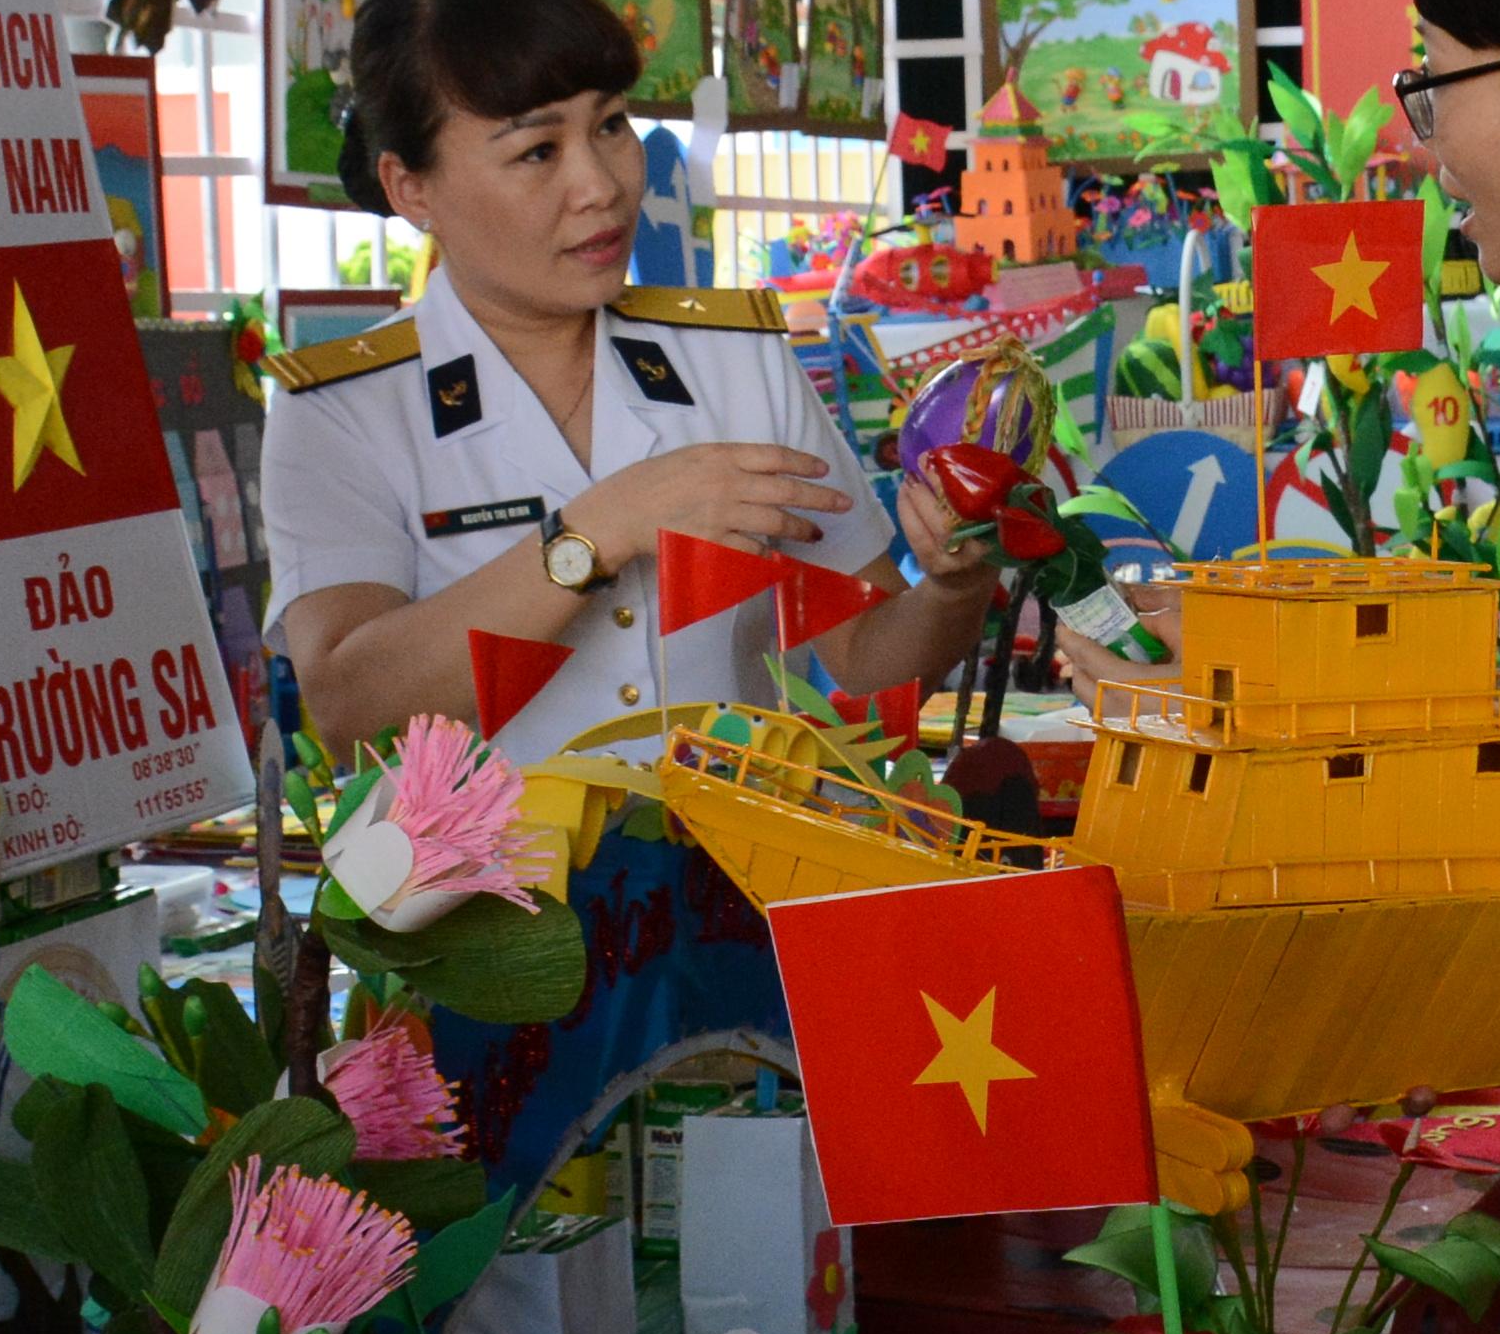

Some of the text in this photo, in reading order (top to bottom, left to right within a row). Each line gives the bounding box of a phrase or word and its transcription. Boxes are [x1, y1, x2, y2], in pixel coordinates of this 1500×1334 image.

[0, 138, 90, 214] NAM
[1427, 395, 1461, 427] 10
[23, 553, 114, 631] ĐẢO
[151, 643, 217, 741] SA
[3, 827, 50, 859] KINH
